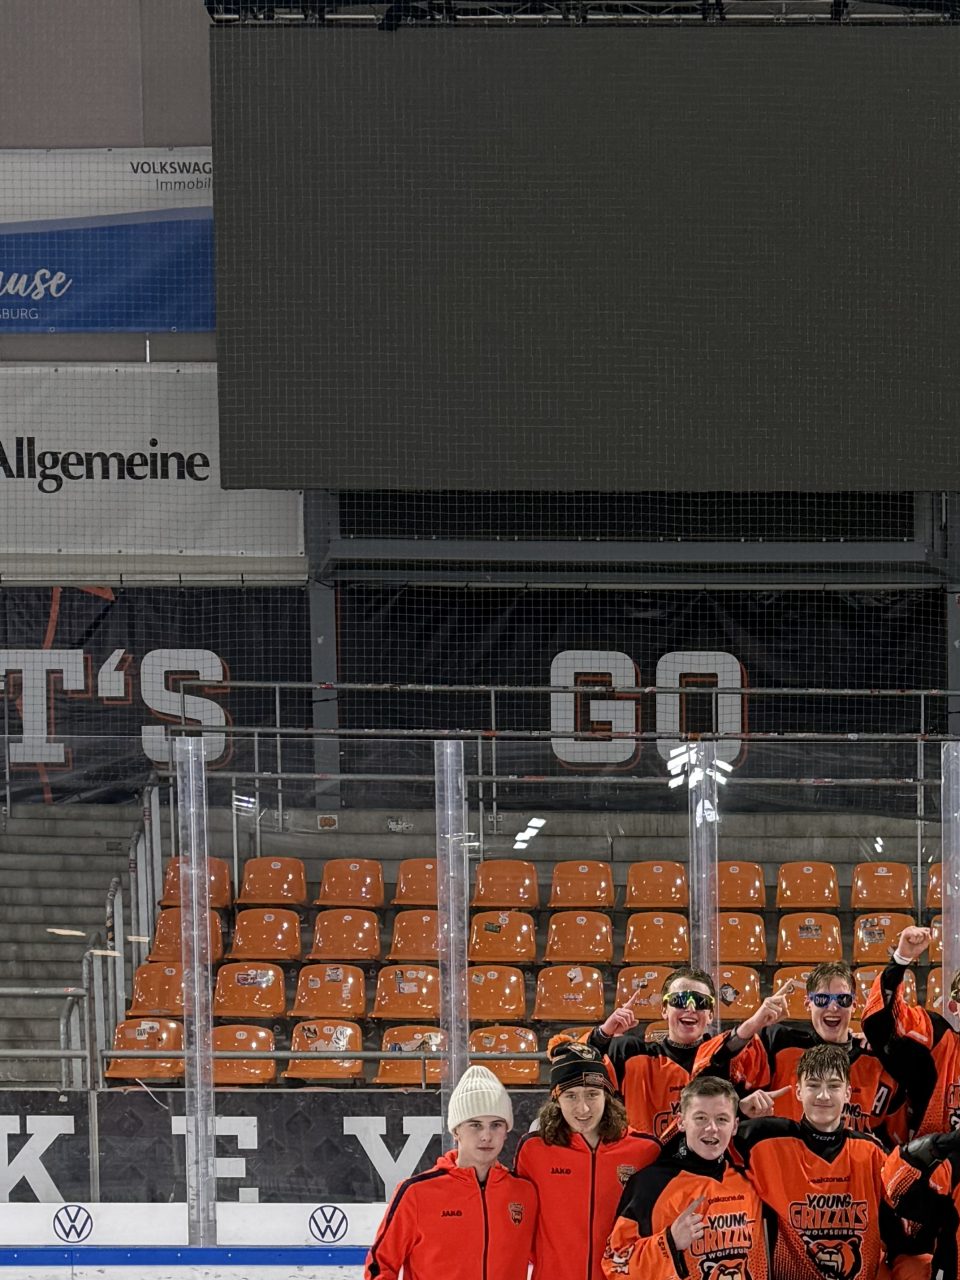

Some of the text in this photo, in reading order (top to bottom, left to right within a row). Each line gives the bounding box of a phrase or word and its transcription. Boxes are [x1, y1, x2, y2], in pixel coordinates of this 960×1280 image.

[0, 269, 73, 300] use
[0, 308, 39, 320] BURG
[0, 436, 211, 493] Allgemeine
[550, 650, 743, 764] GO
[872, 1086, 888, 1114] A
[551, 1167, 572, 1175] JAKO
[806, 1193, 852, 1209] YOUNG
[707, 1212, 748, 1230] YOUNG
[791, 1202, 868, 1230] GRIZZLYS
